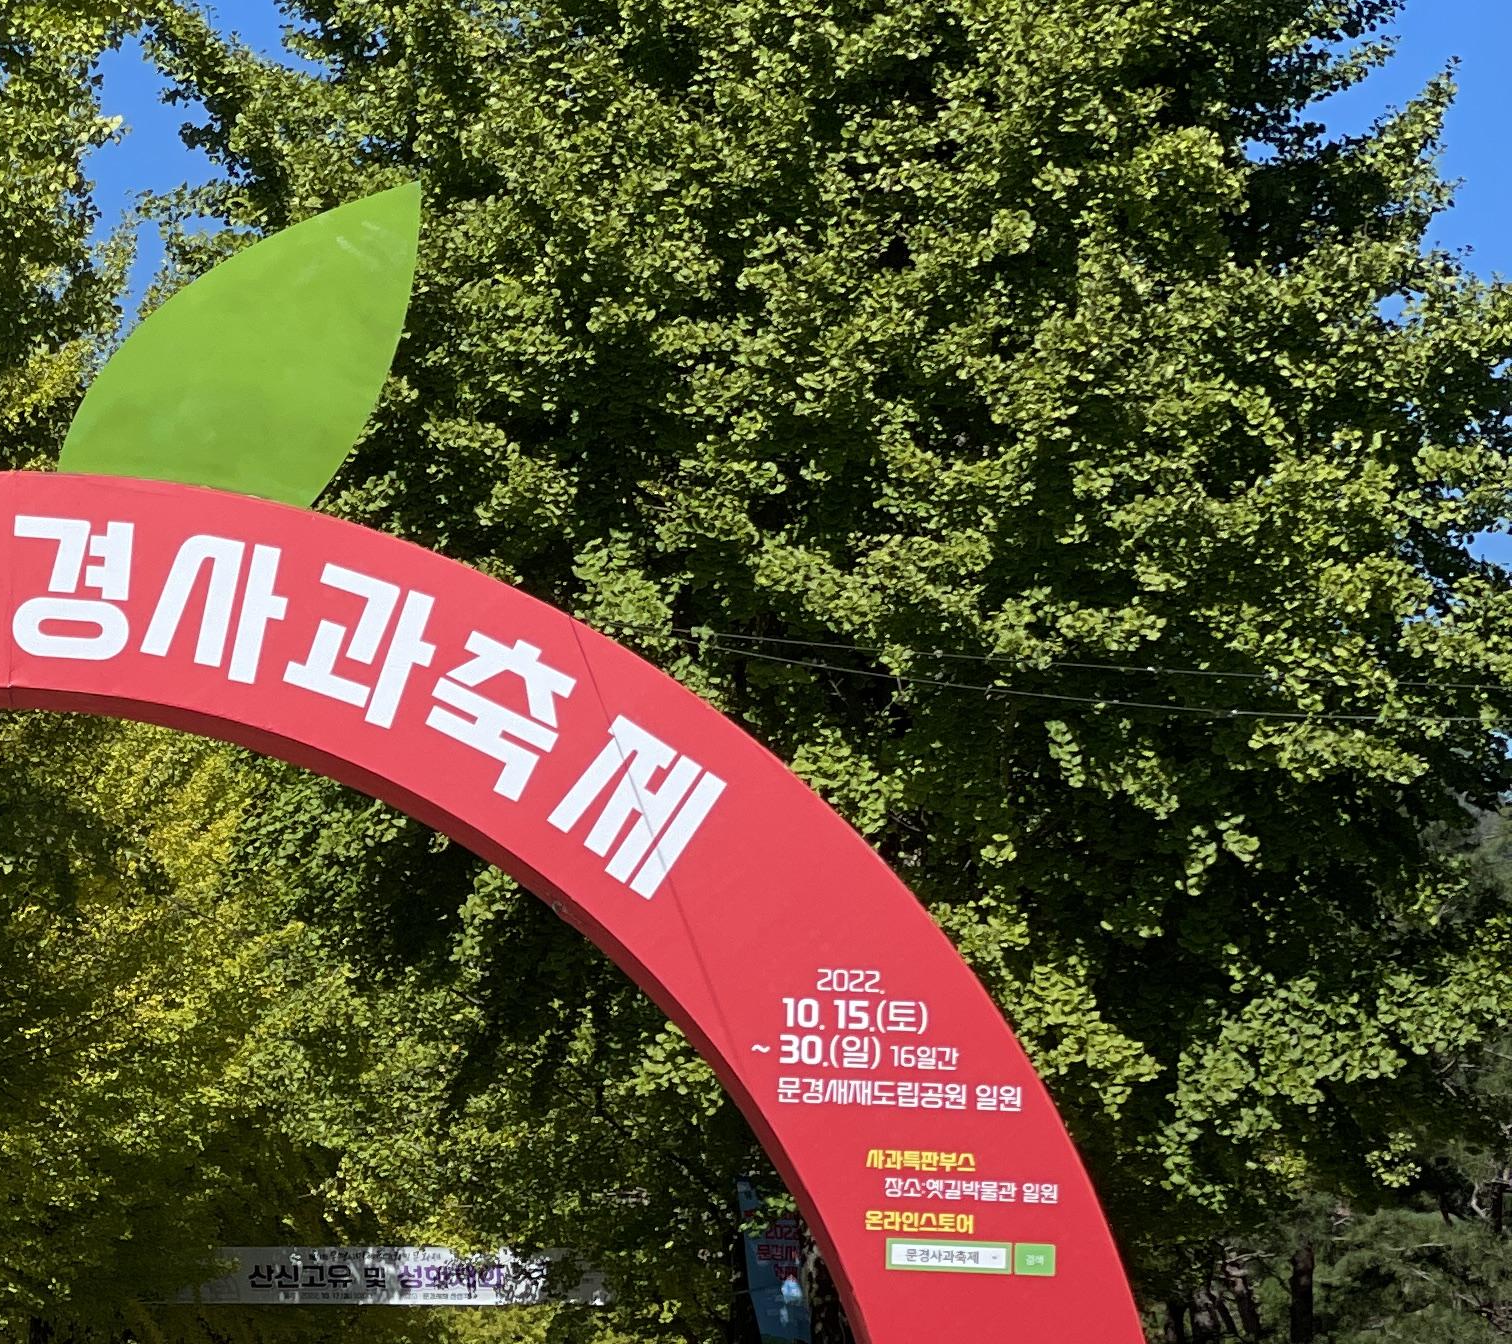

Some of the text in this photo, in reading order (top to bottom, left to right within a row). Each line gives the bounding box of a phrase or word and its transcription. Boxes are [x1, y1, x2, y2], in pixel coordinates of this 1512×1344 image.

[816, 968, 885, 994] 2022.
[779, 1035, 881, 1069] 30.(일)
[890, 1045, 959, 1071] 16일간
[777, 1077, 1022, 1112] 문경새재도립공원 일원
[865, 1149, 976, 1172] 사과특판부스
[1022, 1182, 1058, 1204] 일원
[865, 1210, 975, 1234] 온라인스토어
[905, 1248, 980, 1265] 문경사과축제
[248, 1264, 352, 1290] 산신고유
[365, 1265, 386, 1289] 및
